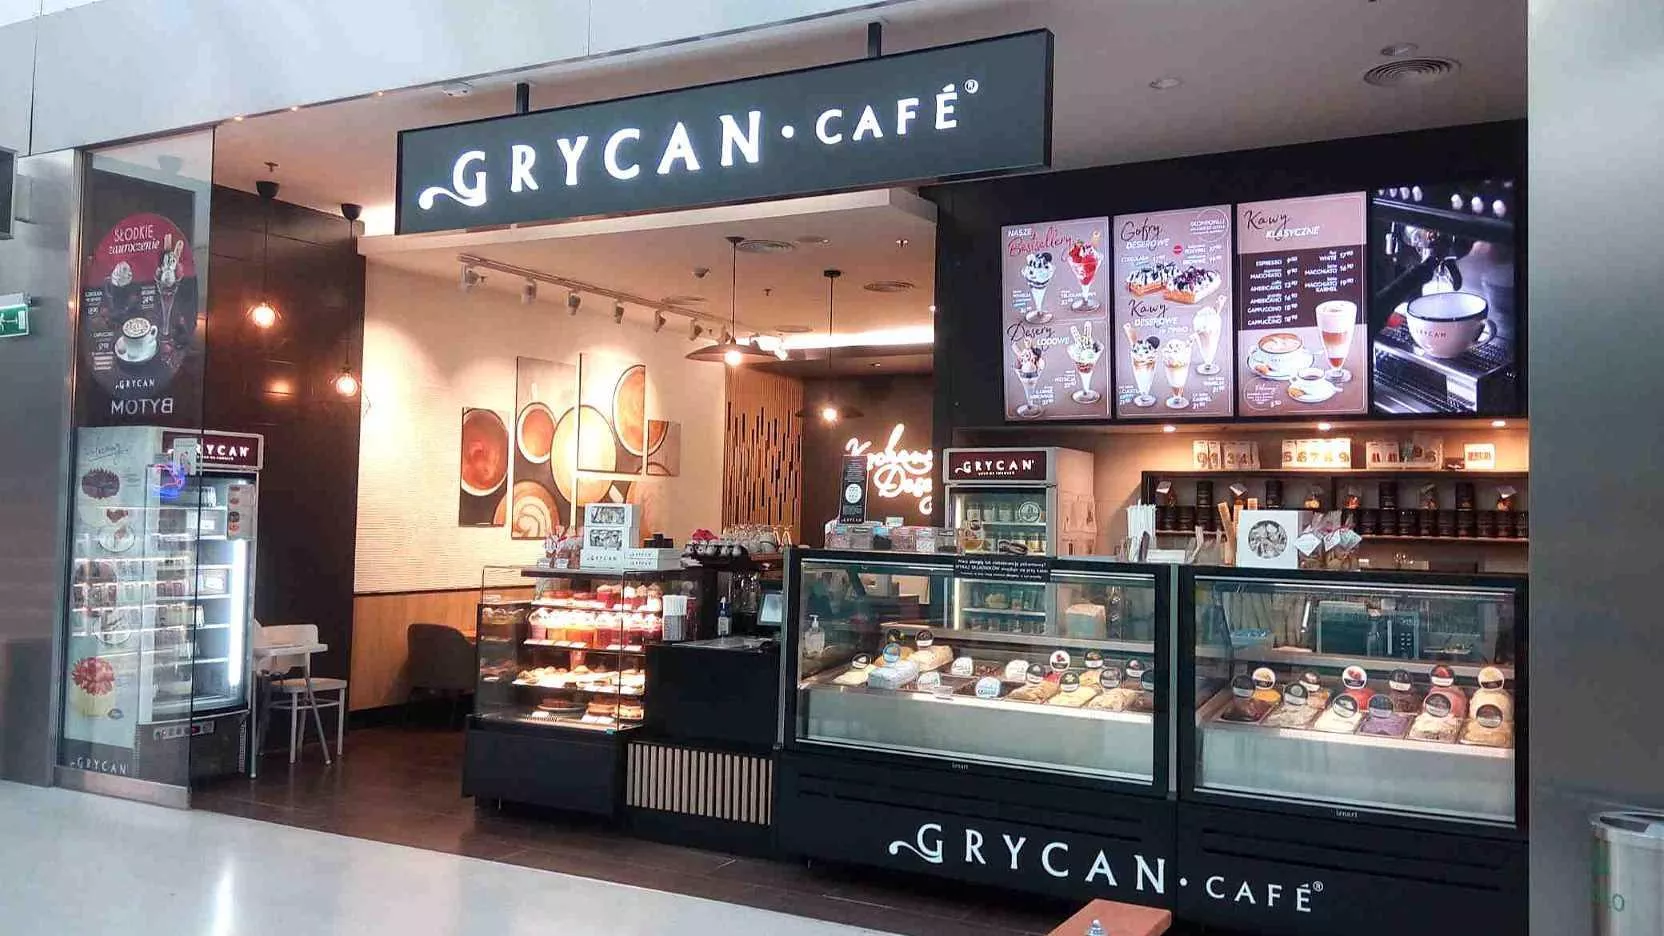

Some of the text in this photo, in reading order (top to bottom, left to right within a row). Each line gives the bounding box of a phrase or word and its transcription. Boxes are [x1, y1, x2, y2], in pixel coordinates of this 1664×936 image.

[418, 110, 763, 208] GRYCAN
[114, 224, 155, 242] SŁODKIE
[1008, 228, 1032, 237] NASZE
[1244, 210, 1288, 241] Kawy
[1266, 226, 1320, 239] KLASYCZNE
[1129, 300, 1167, 326] Kawy
[115, 378, 155, 390] GRYCAN
[889, 823, 1165, 893] GRYCAN
